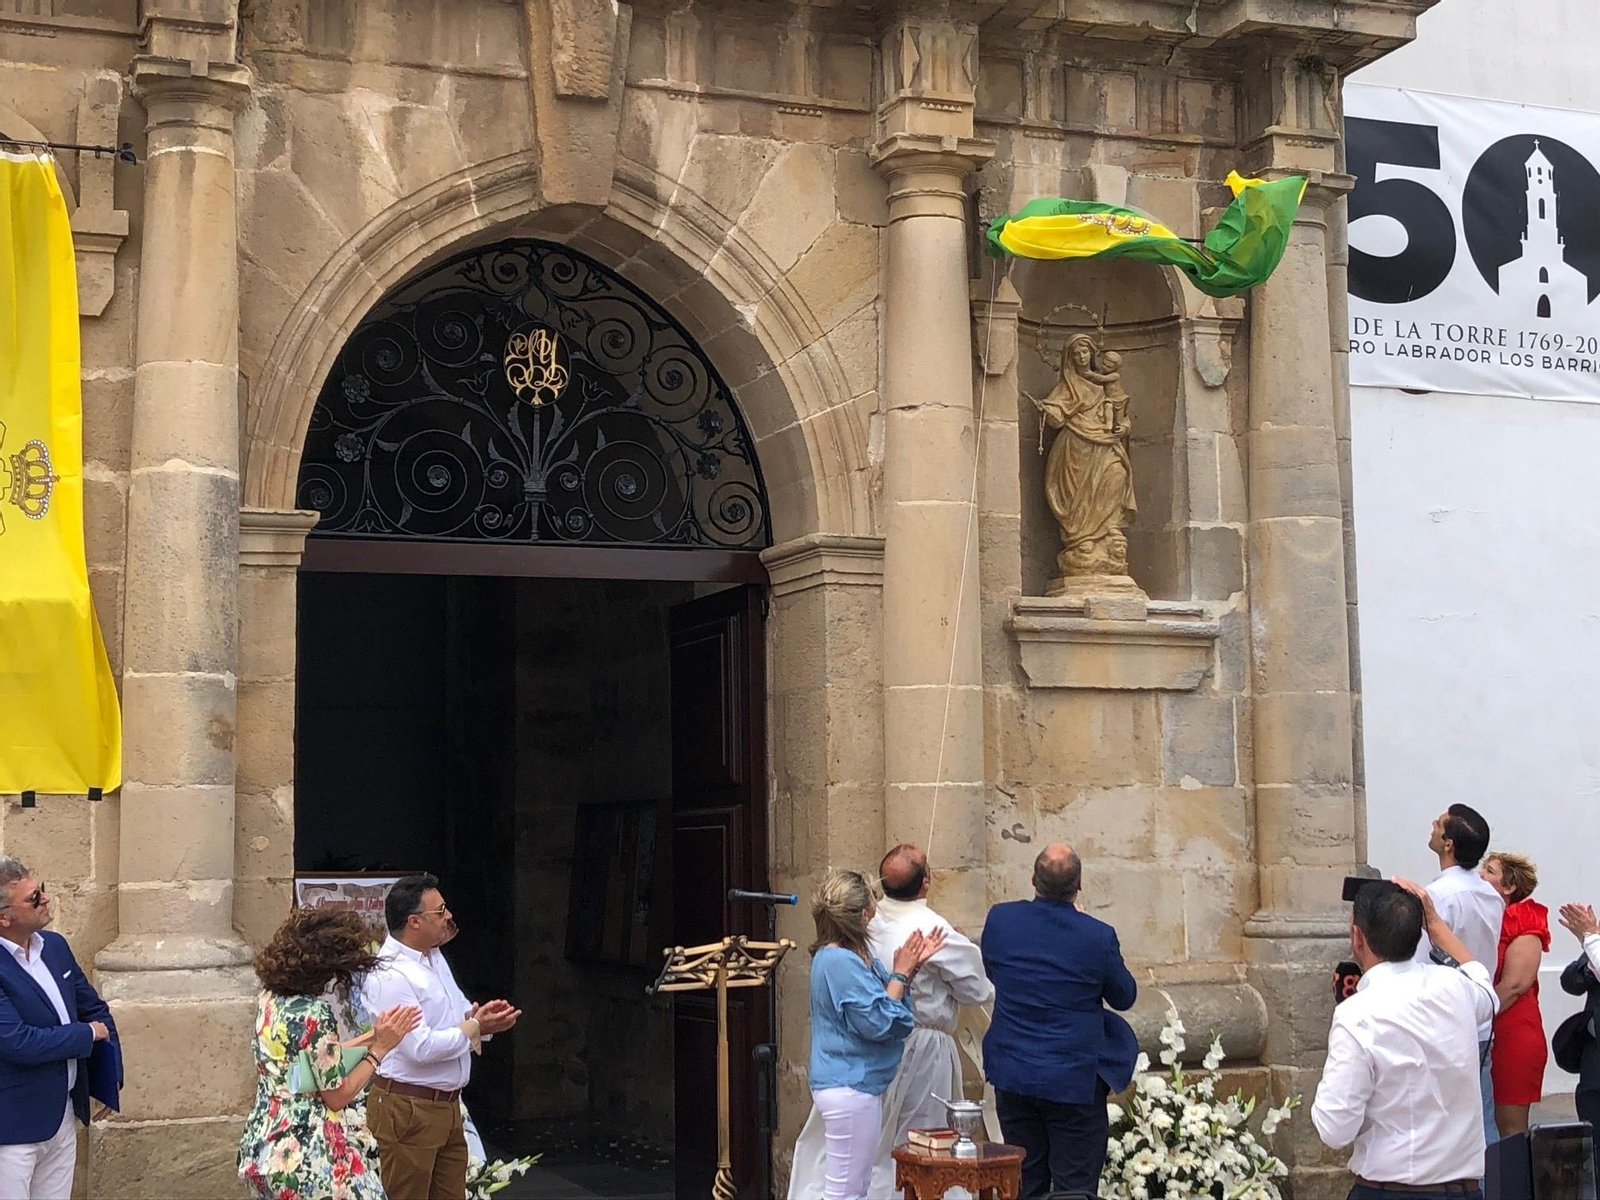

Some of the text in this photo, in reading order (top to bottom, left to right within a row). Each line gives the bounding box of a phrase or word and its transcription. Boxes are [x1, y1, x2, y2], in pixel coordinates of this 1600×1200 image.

[1353, 316, 1599, 355] DE LA TORRE 1769-20
[1349, 339, 1600, 373] RO LABRADOR LOS BARRI
